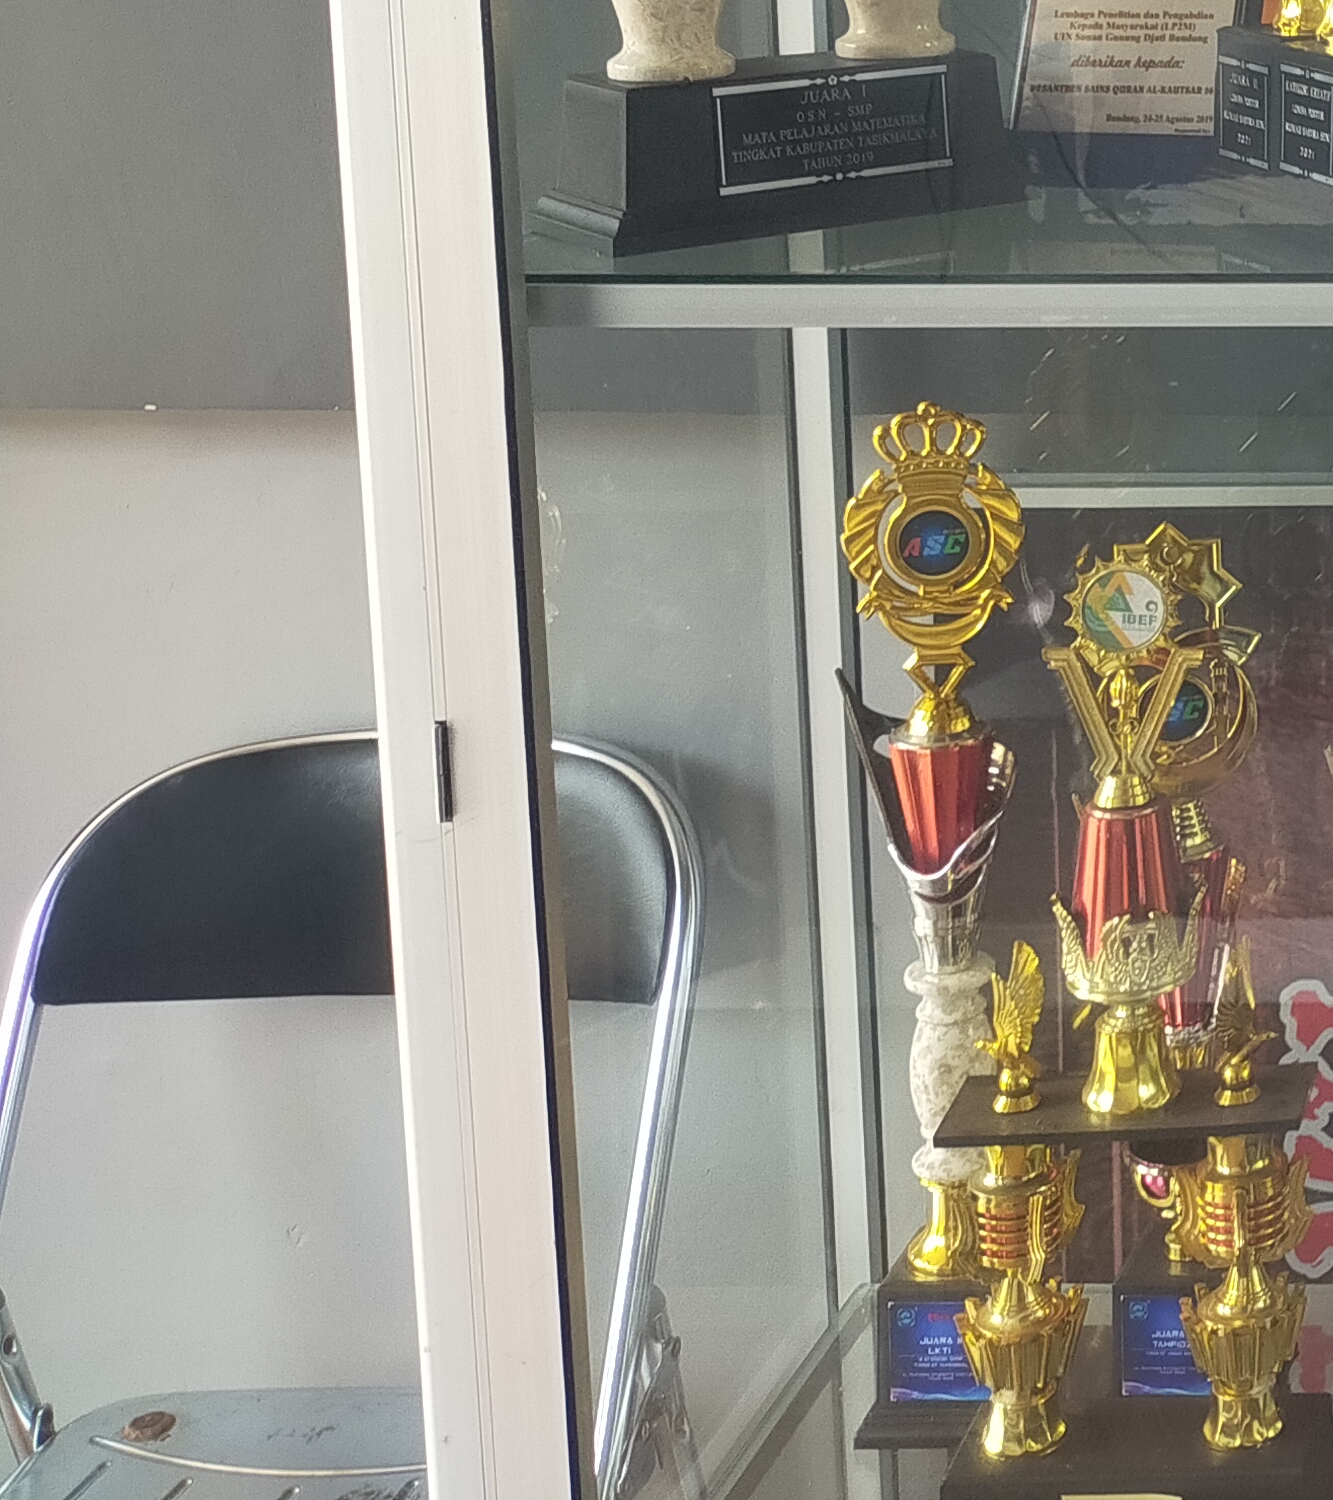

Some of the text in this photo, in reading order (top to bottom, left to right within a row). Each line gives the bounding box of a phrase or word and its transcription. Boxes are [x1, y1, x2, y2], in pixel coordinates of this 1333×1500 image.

[1097, 10, 1141, 20] Penelitian
[1143, 10, 1160, 20] dan
[1162, 10, 1215, 21] Pengabdian
[1105, 21, 1159, 32] Masyarakat
[1070, 54, 1131, 69] diberikan
[800, 86, 852, 106] JUARA
[847, 103, 874, 119] SMP
[742, 113, 927, 146] MATA PELAJARAN MATEMATIKA
[731, 128, 938, 164] TINGKAT KABUPATEN TASIKMALAYA
[803, 156, 844, 171] TAHUN
[903, 533, 967, 558] ASC
[919, 1336, 953, 1345] JUARA
[1151, 1330, 1185, 1338] JUARA
[928, 1347, 951, 1355] LKTI
